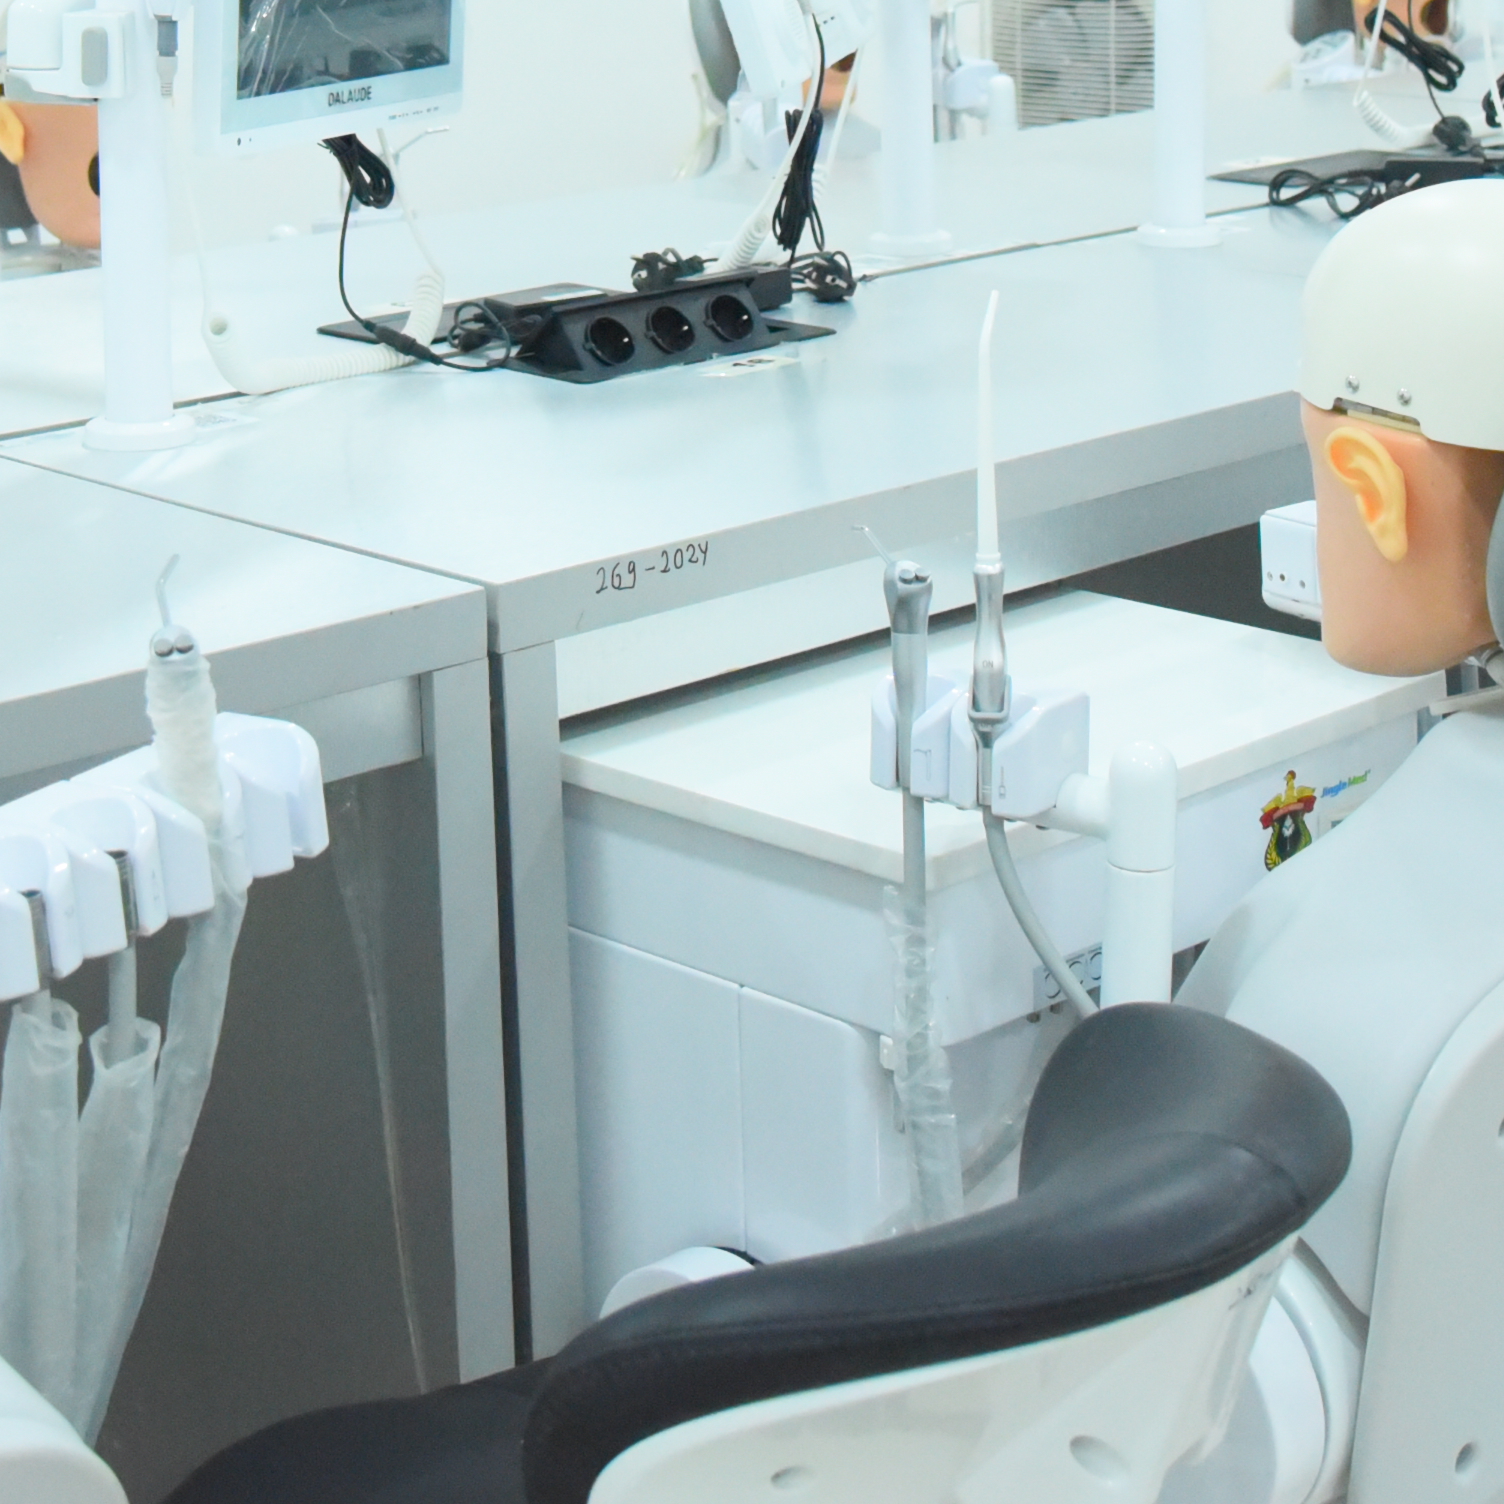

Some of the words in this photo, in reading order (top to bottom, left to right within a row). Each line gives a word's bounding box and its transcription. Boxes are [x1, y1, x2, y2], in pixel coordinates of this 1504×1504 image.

[328, 85, 372, 107] DALAUDE
[595, 540, 709, 594] 269-2024
[982, 660, 994, 668] ON
